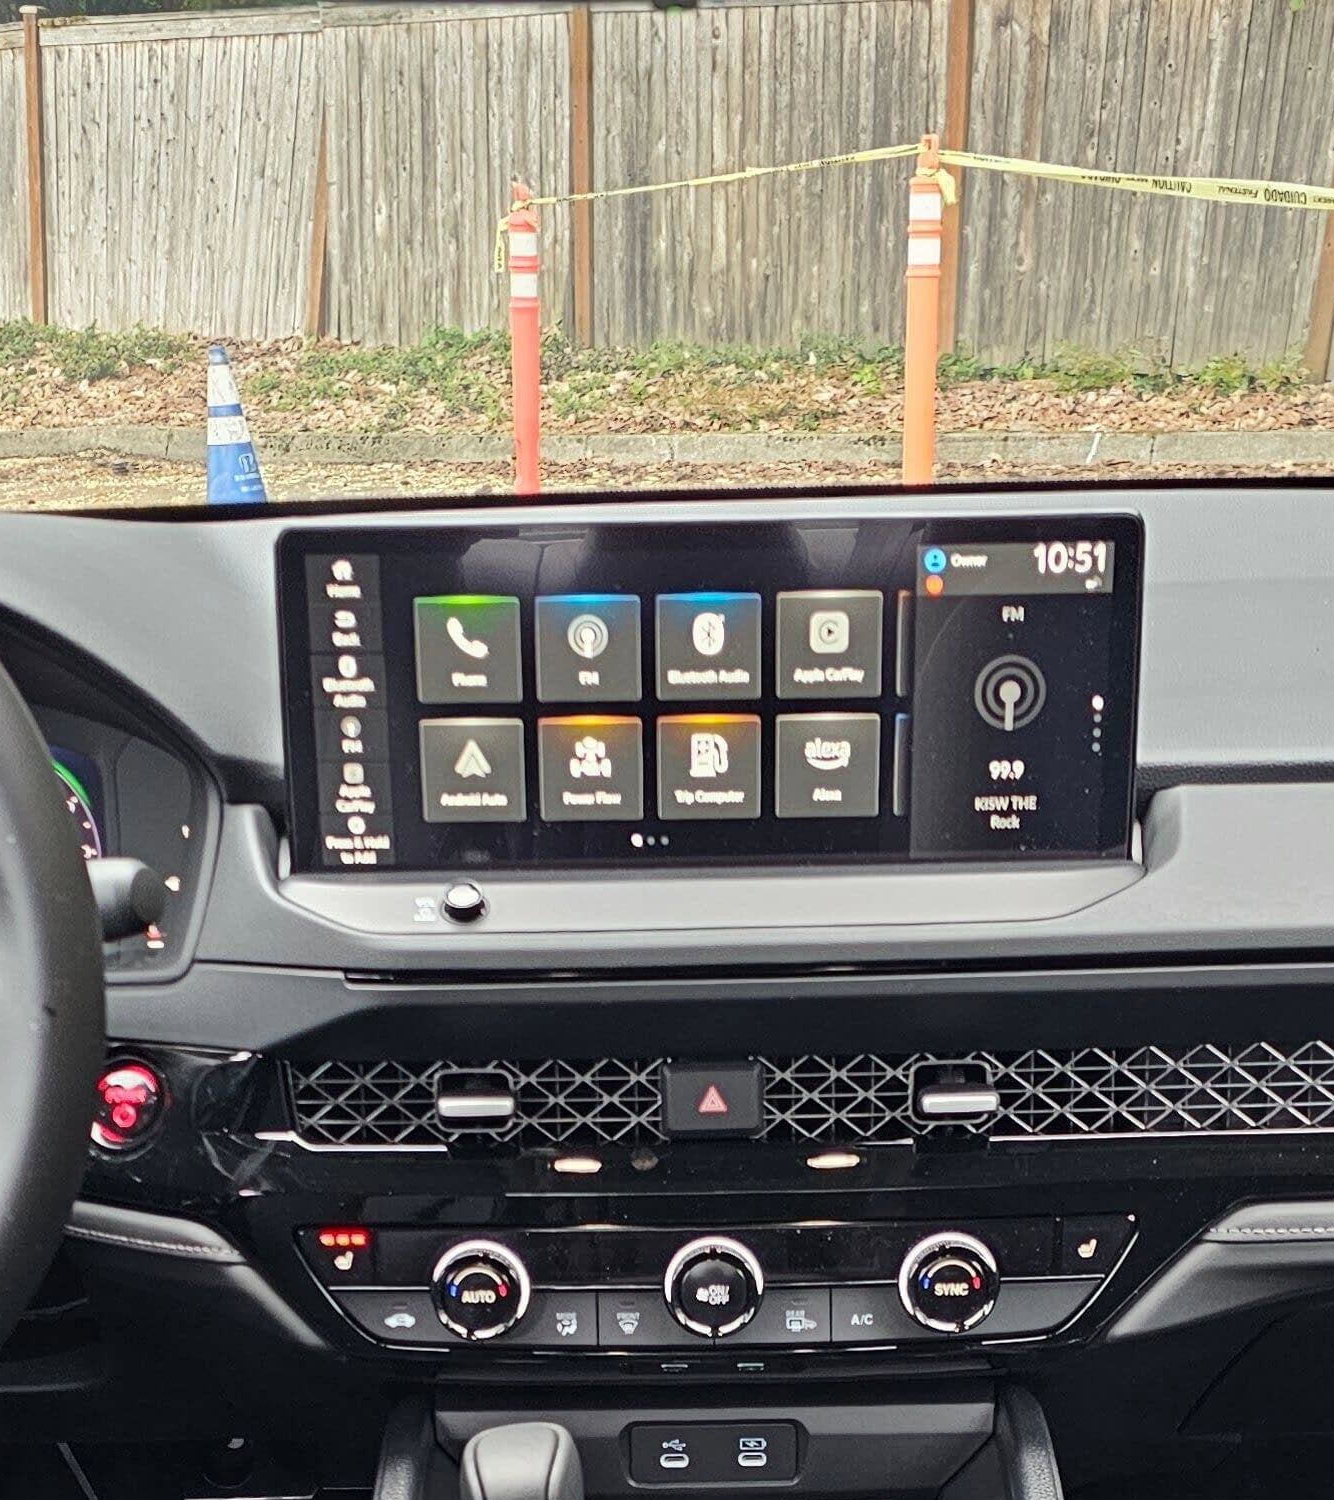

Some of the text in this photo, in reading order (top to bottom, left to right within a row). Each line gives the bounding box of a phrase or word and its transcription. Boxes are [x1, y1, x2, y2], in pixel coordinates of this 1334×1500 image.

[1264, 188, 1308, 206] CUIDADO
[1033, 540, 1107, 574] 10:51
[1002, 605, 1025, 622] FM
[578, 670, 600, 686] FM
[804, 737, 851, 760] alexa
[988, 759, 1025, 780] 99.9
[974, 795, 1038, 811] KISW THE
[990, 814, 1020, 830] Rock
[461, 1290, 496, 1304] AUTO
[934, 1282, 969, 1296] SYNC
[708, 1295, 729, 1305] OFF
[851, 1314, 874, 1326] A/C
